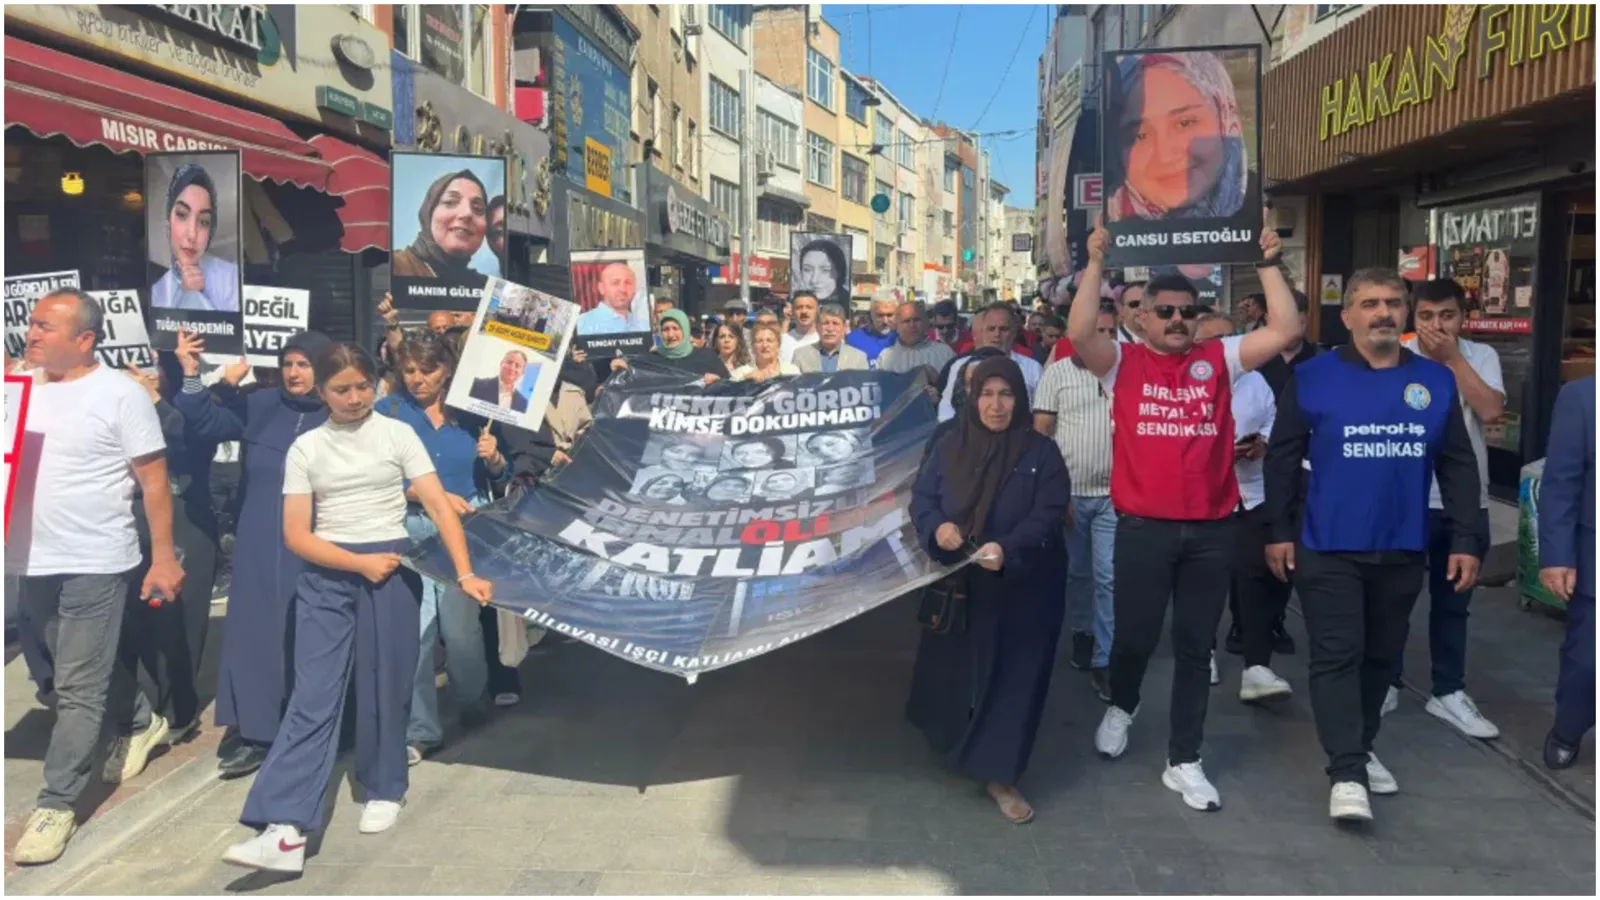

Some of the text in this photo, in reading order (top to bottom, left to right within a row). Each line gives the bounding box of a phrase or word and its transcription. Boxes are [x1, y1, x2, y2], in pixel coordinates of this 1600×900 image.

[1320, 34, 1466, 141] HAKAN
[101, 117, 160, 150] MISIR
[1115, 227, 1251, 247] CANSU ESETOĞLU
[408, 286, 447, 296] HANIM
[245, 296, 299, 319] DEĞİL
[773, 382, 883, 414] GÖRDÜ
[1143, 383, 1210, 404] BİRLEŞİK
[648, 404, 882, 436] KİMSE DOKUNMADI
[1139, 403, 1188, 420] METAL
[1137, 422, 1218, 437] SENDİKASI
[1343, 439, 1427, 458] SENDİKASI
[560, 508, 904, 577] KATLİAM
